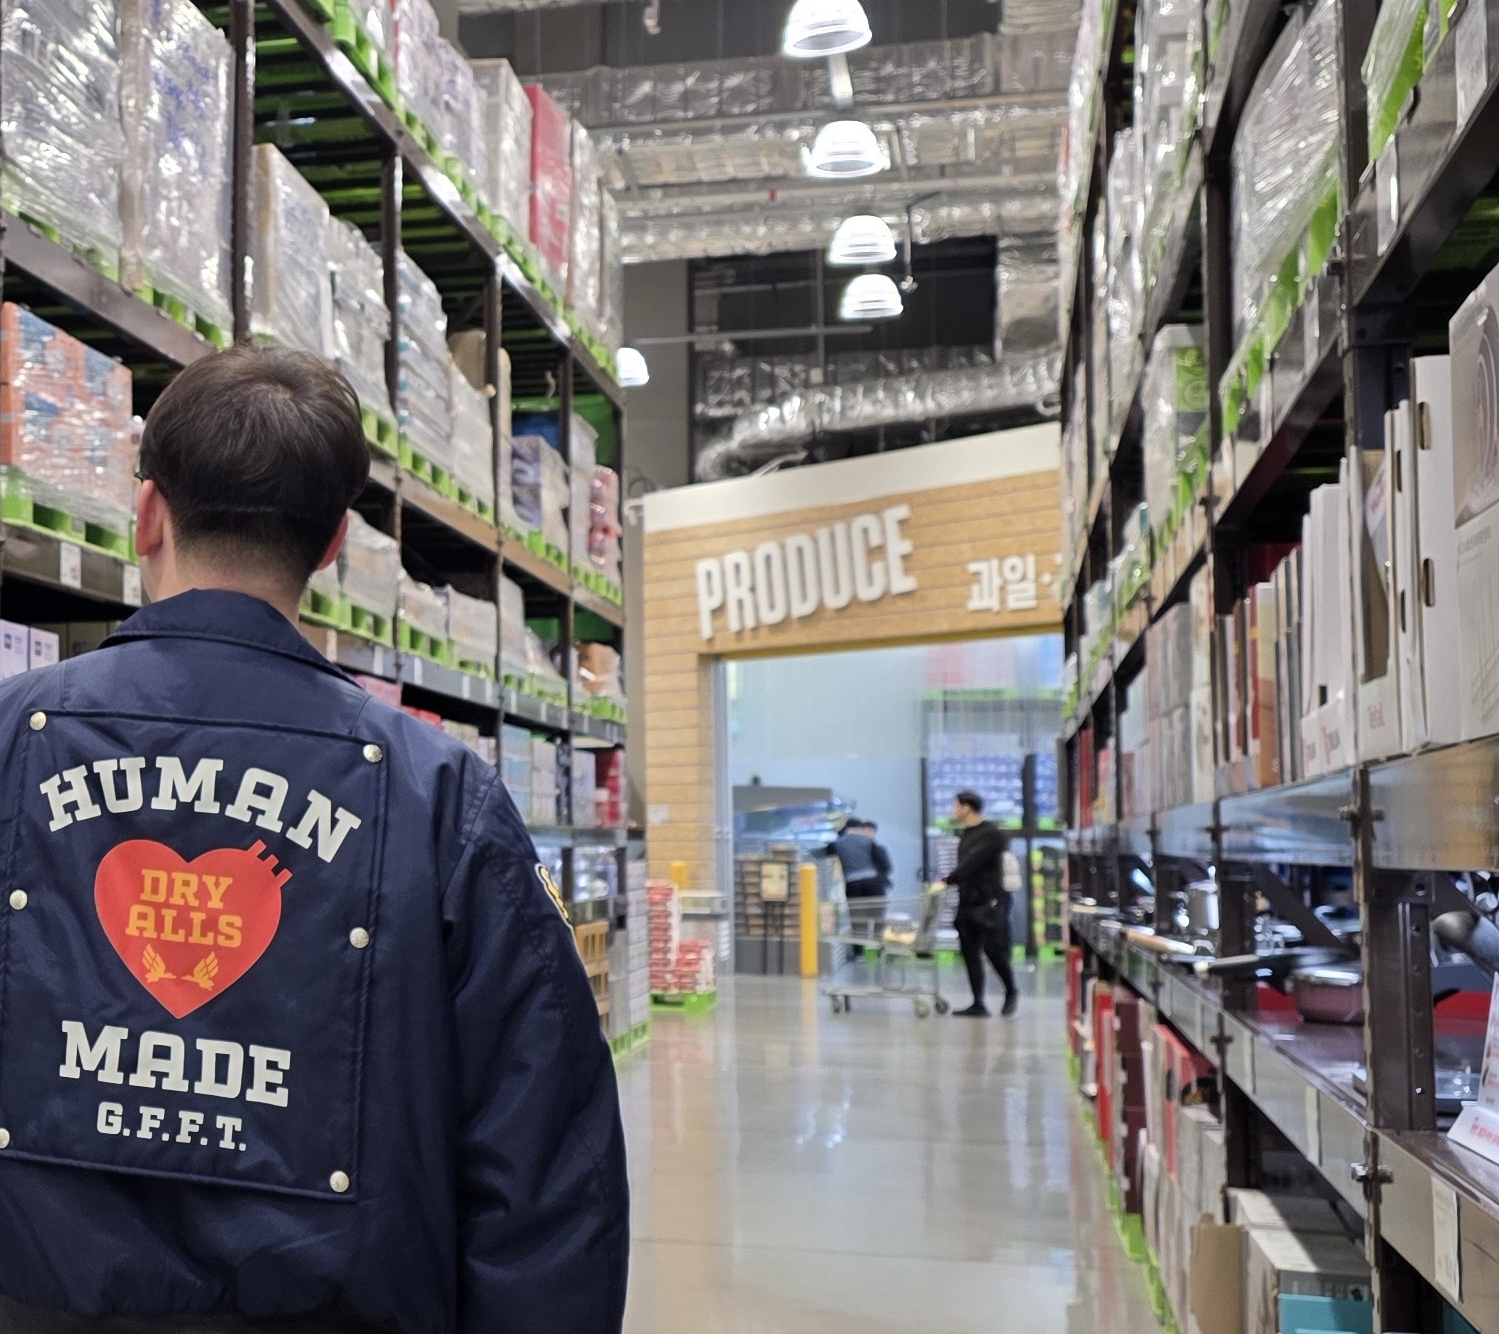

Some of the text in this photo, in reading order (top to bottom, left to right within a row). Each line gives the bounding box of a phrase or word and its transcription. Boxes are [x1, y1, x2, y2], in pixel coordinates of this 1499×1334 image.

[695, 503, 918, 640] PRODUCE
[39, 755, 361, 863] HUMAN
[140, 867, 233, 909] DRY
[125, 904, 243, 949] ALLS
[58, 1019, 291, 1108] MADE
[96, 1101, 247, 1151] G.F.F.T.
